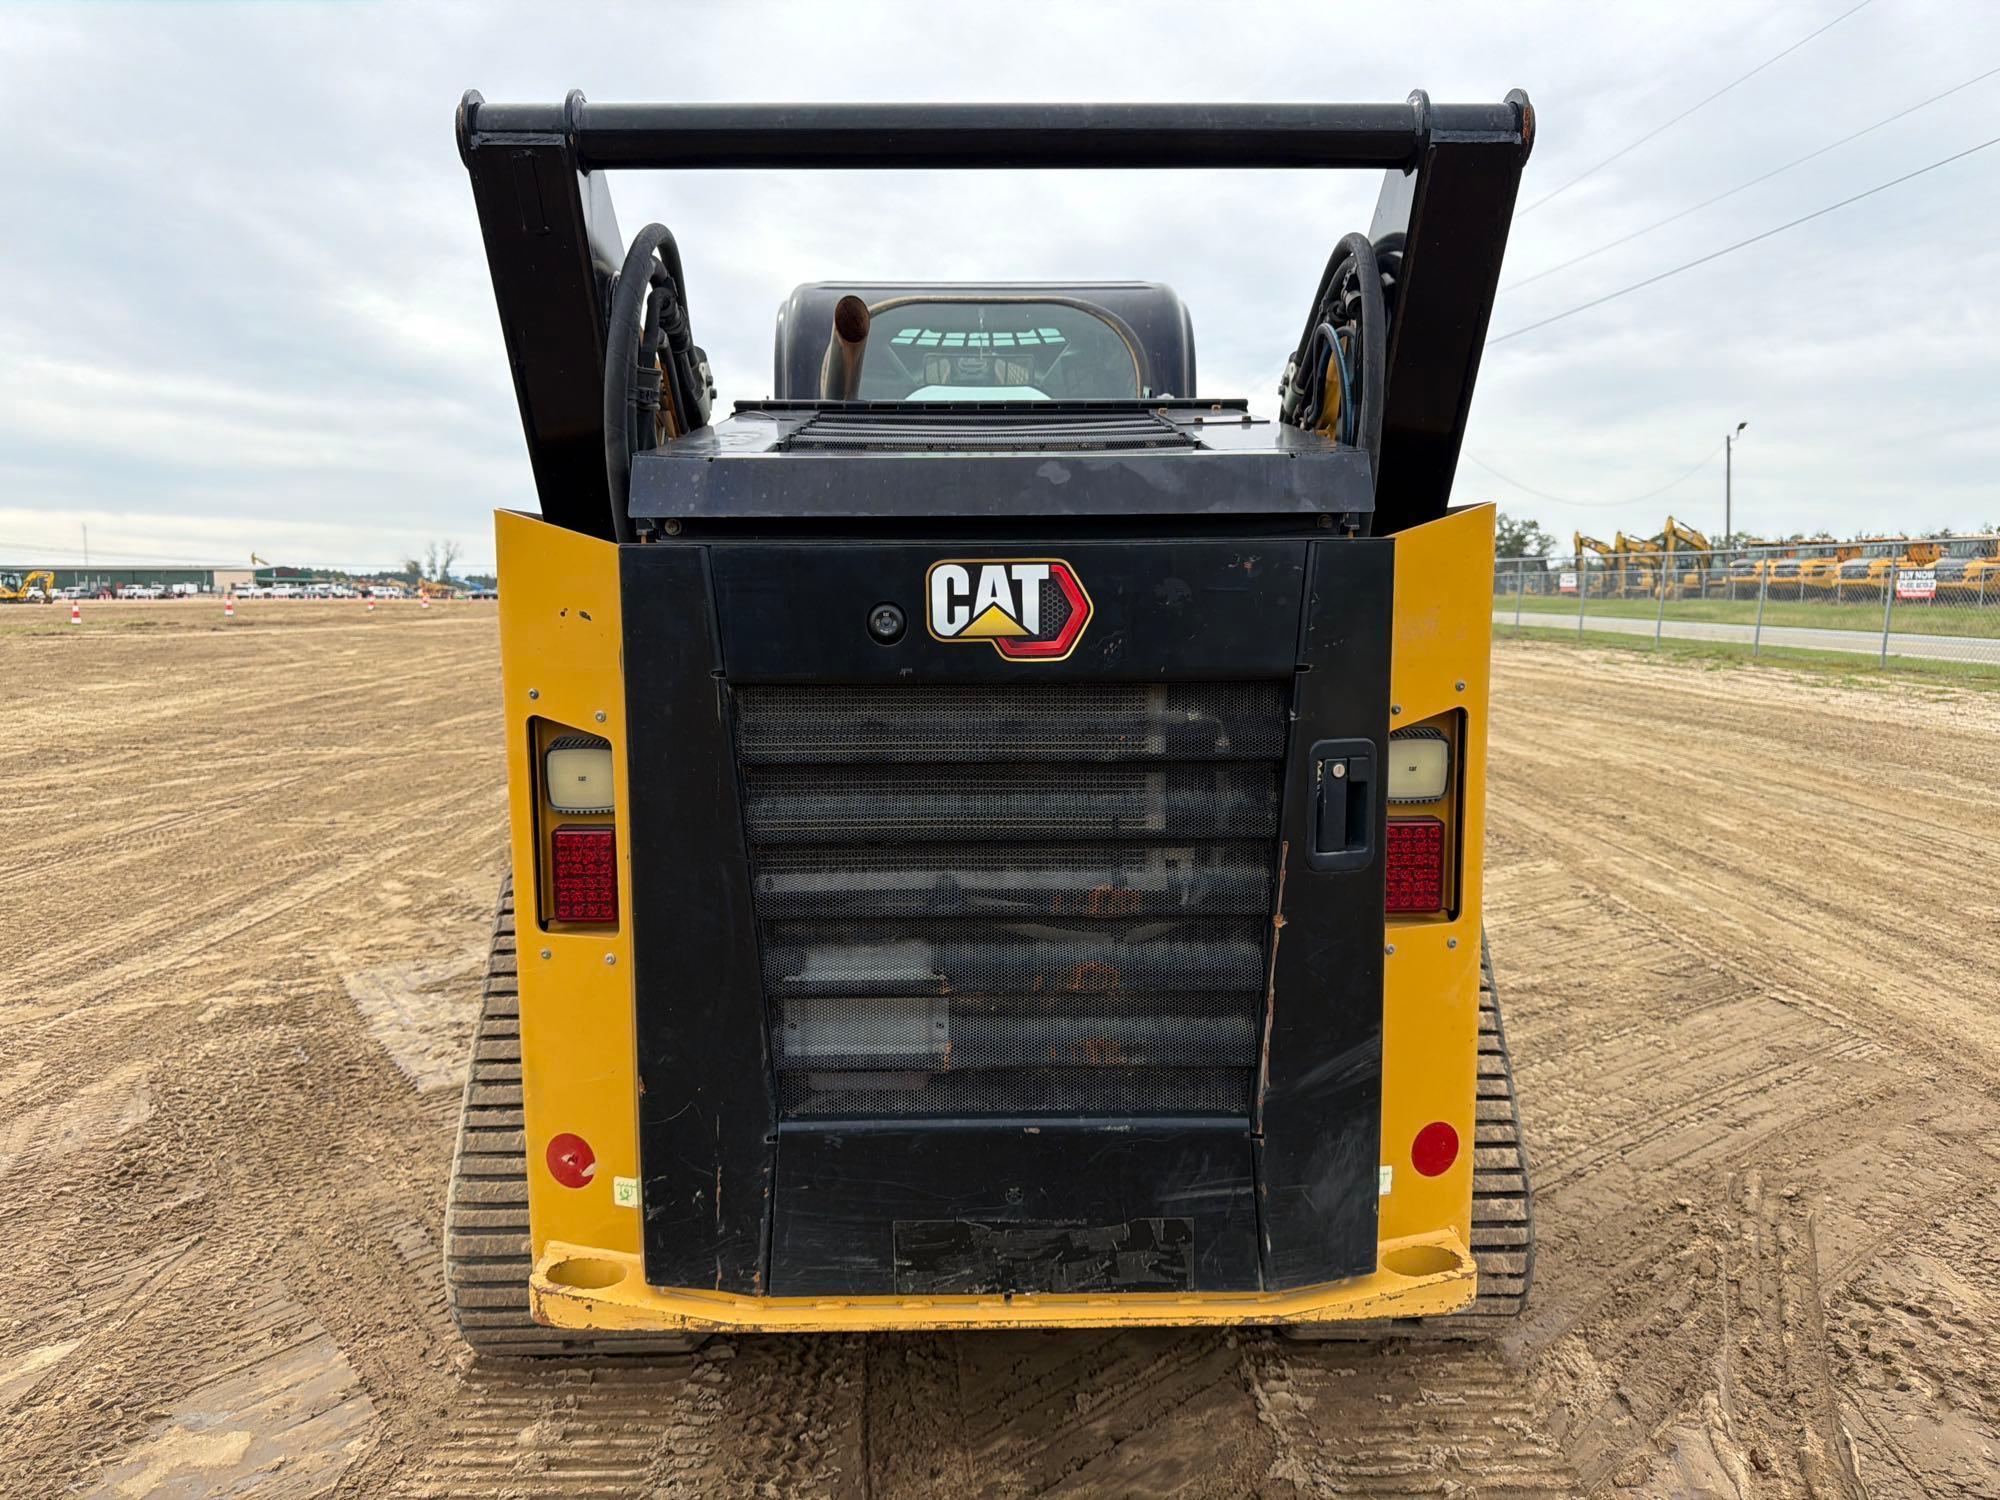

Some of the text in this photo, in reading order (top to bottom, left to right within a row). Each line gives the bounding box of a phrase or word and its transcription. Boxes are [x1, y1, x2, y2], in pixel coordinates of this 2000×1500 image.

[1899, 570, 1935, 580] BUY NOW
[932, 564, 1049, 636] CAT
